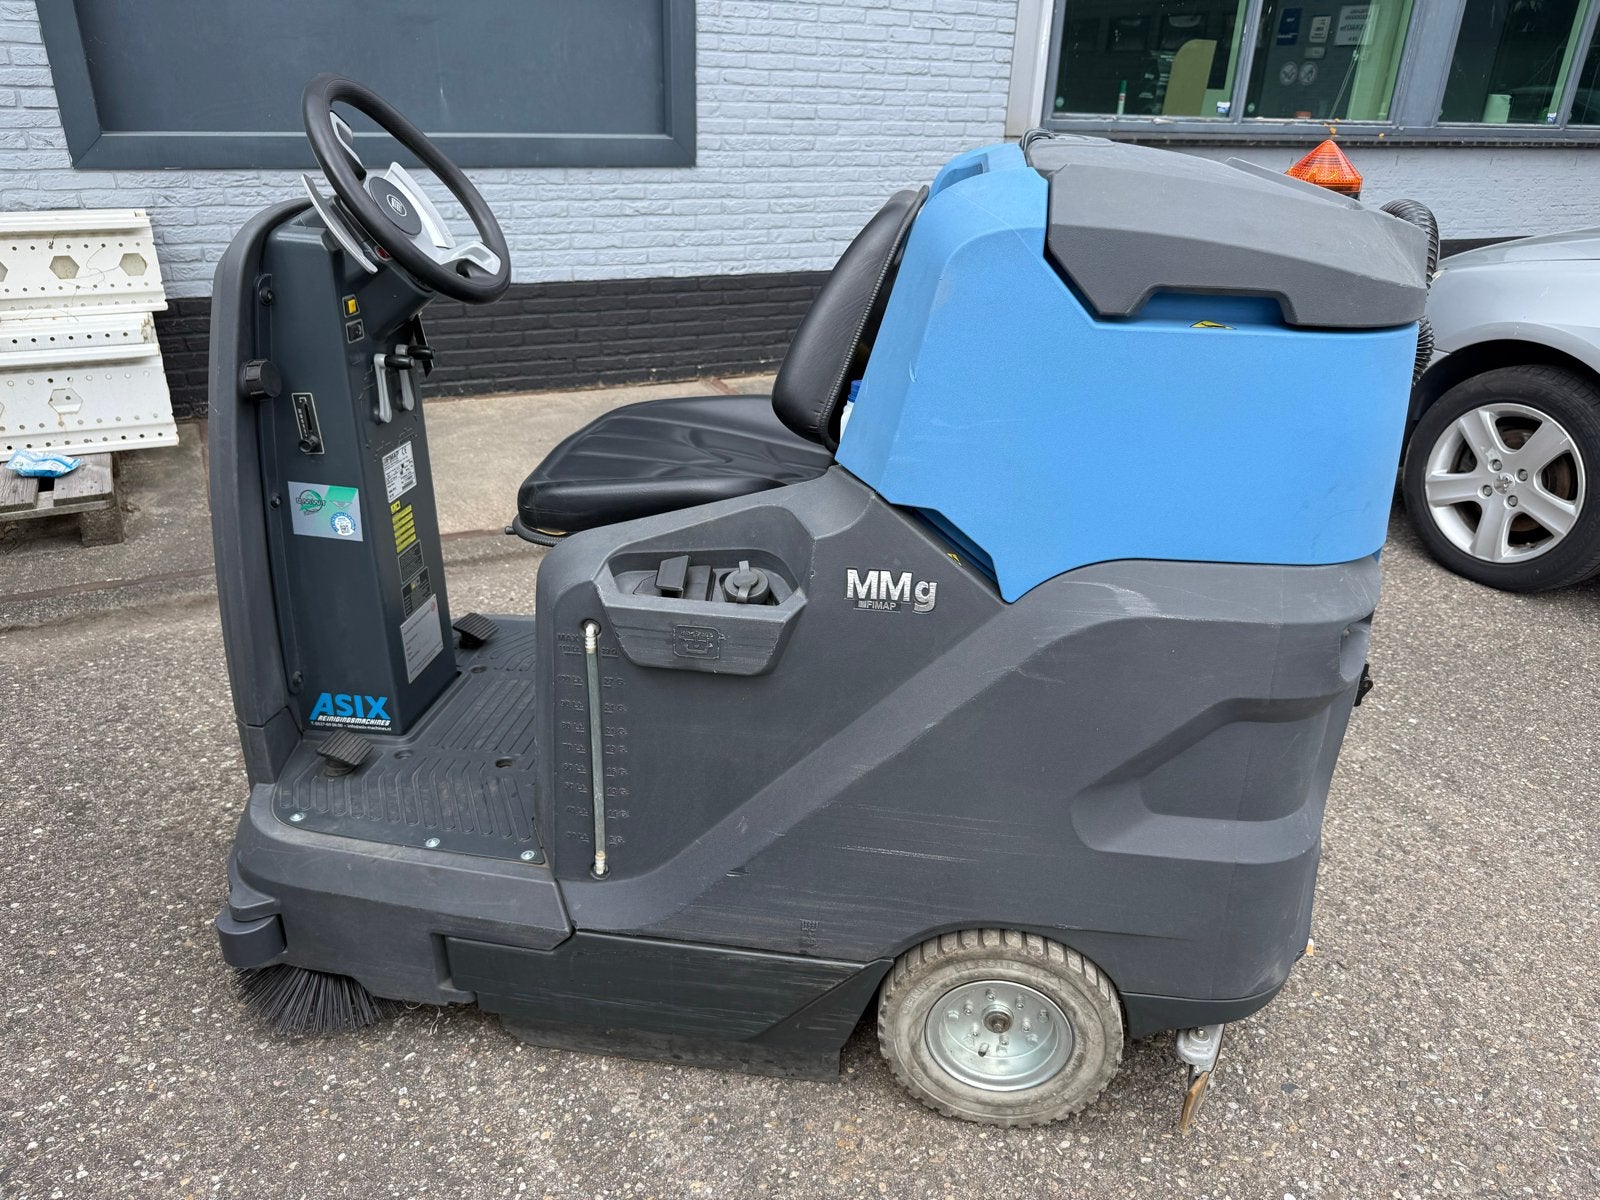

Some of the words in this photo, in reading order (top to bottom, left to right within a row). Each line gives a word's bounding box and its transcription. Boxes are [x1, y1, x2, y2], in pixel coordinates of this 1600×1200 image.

[846, 568, 938, 613] MMg
[865, 600, 897, 610] FIMAP
[557, 632, 579, 642] MAX
[309, 692, 391, 720] ASIX
[317, 715, 391, 726] REINIGINGSMACHINES
